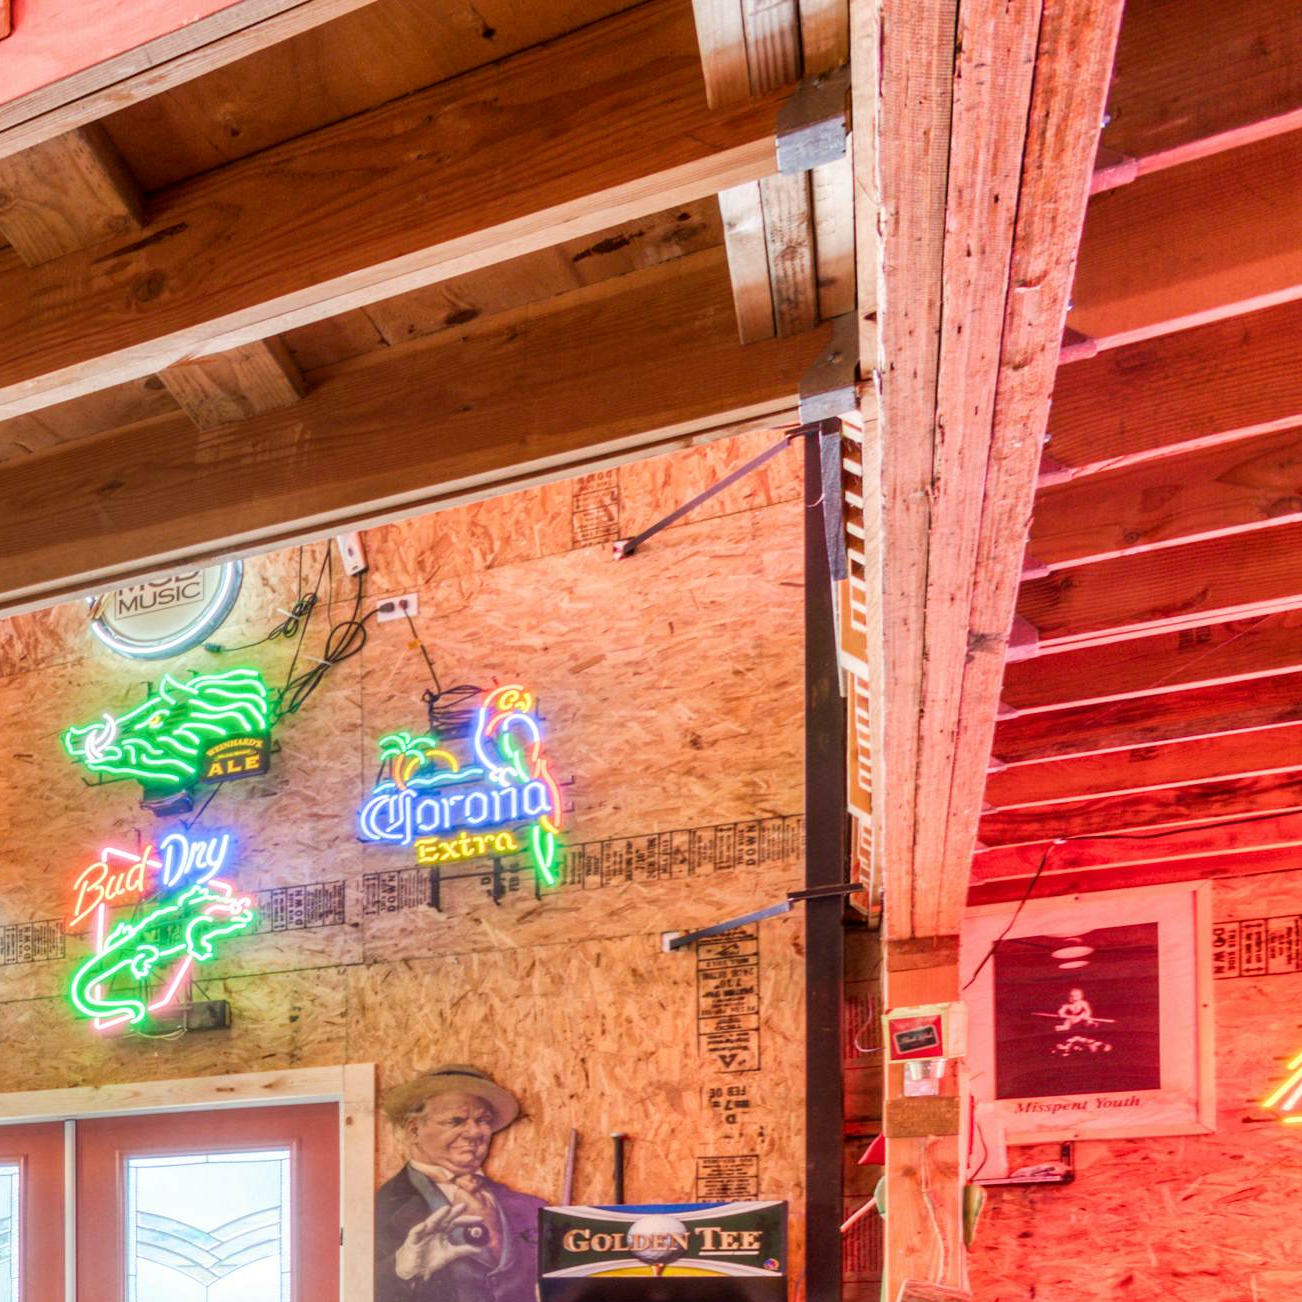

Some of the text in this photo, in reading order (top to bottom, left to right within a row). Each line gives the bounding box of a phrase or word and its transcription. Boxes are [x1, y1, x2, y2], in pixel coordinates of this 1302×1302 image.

[118, 581, 201, 616] MUSIC
[207, 754, 260, 777] ALE
[360, 781, 553, 846] Corona
[414, 831, 518, 863] Extra
[745, 824, 756, 866] DOWN
[69, 833, 230, 927] Bud Dry
[386, 873, 397, 913] DOWN
[294, 889, 304, 926] DOWN
[23, 926, 31, 960] DOWN
[1212, 927, 1226, 975] DOWN
[1014, 1095, 1141, 1115] Misspent Youth
[563, 1226, 763, 1253] GOLDEN TEE
